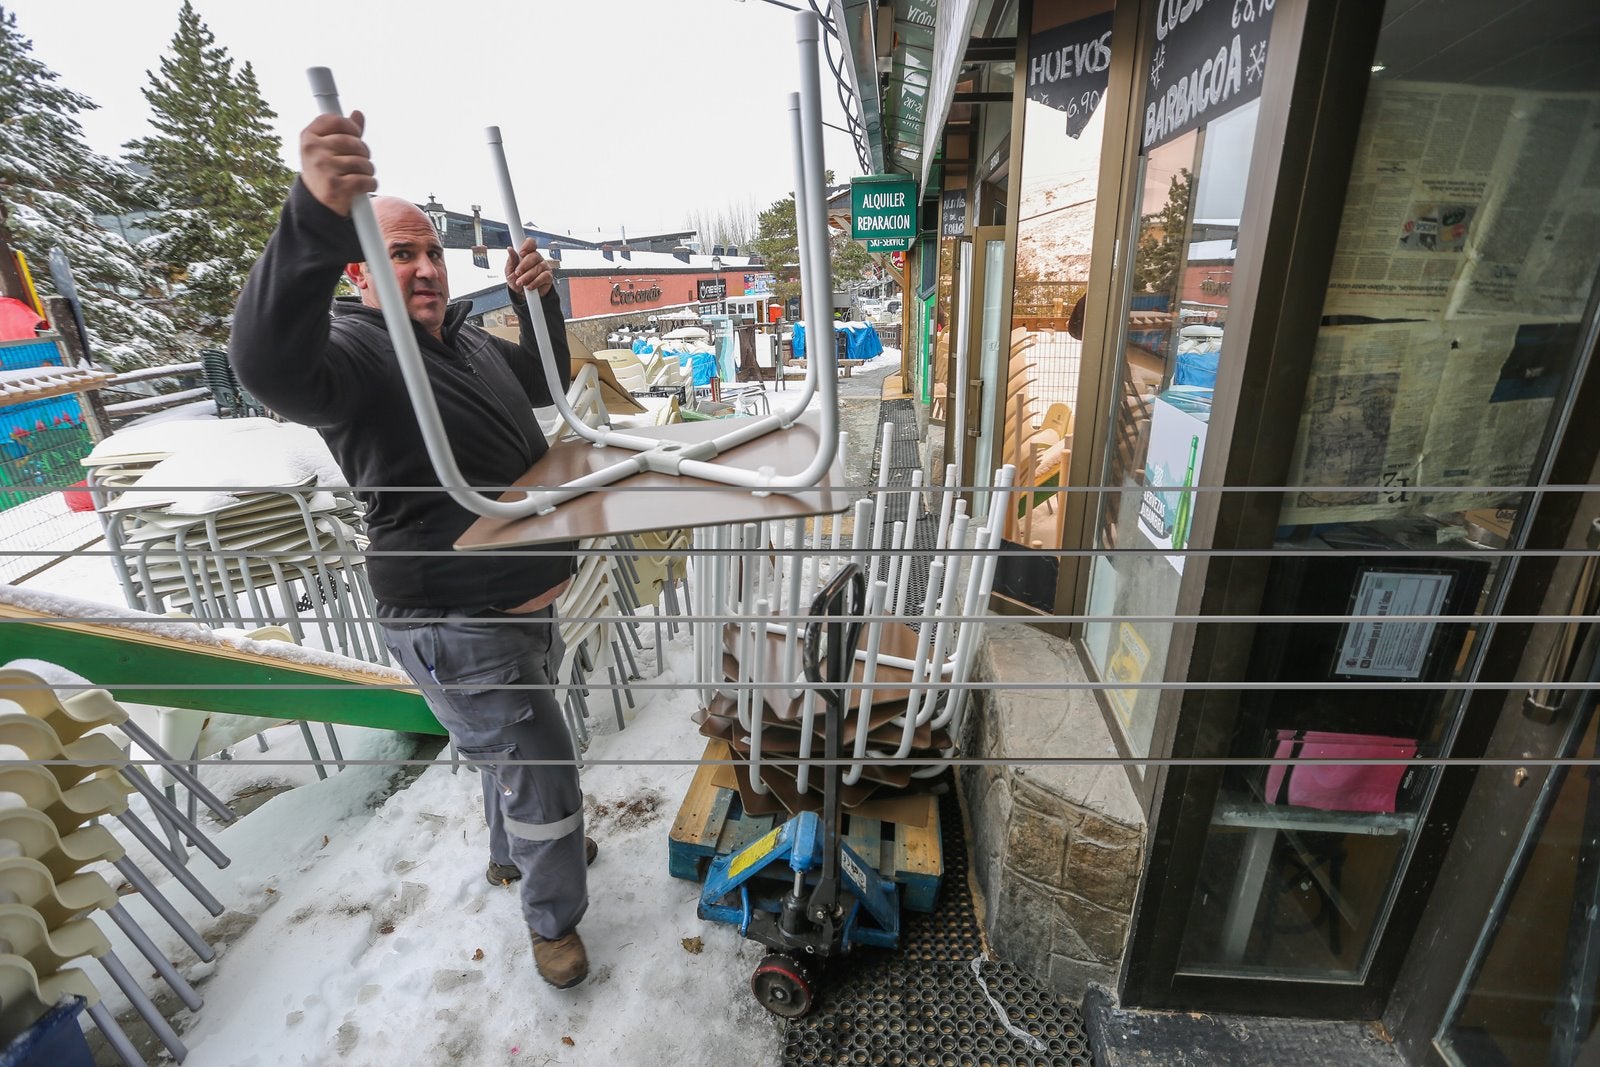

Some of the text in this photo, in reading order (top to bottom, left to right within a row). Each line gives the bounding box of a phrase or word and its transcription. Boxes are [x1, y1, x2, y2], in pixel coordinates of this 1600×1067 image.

[1030, 30, 1112, 86] HUEVOS
[1143, 34, 1242, 148] BARBACOA
[863, 192, 905, 210] ALQUILER
[857, 215, 910, 231] REPARACION
